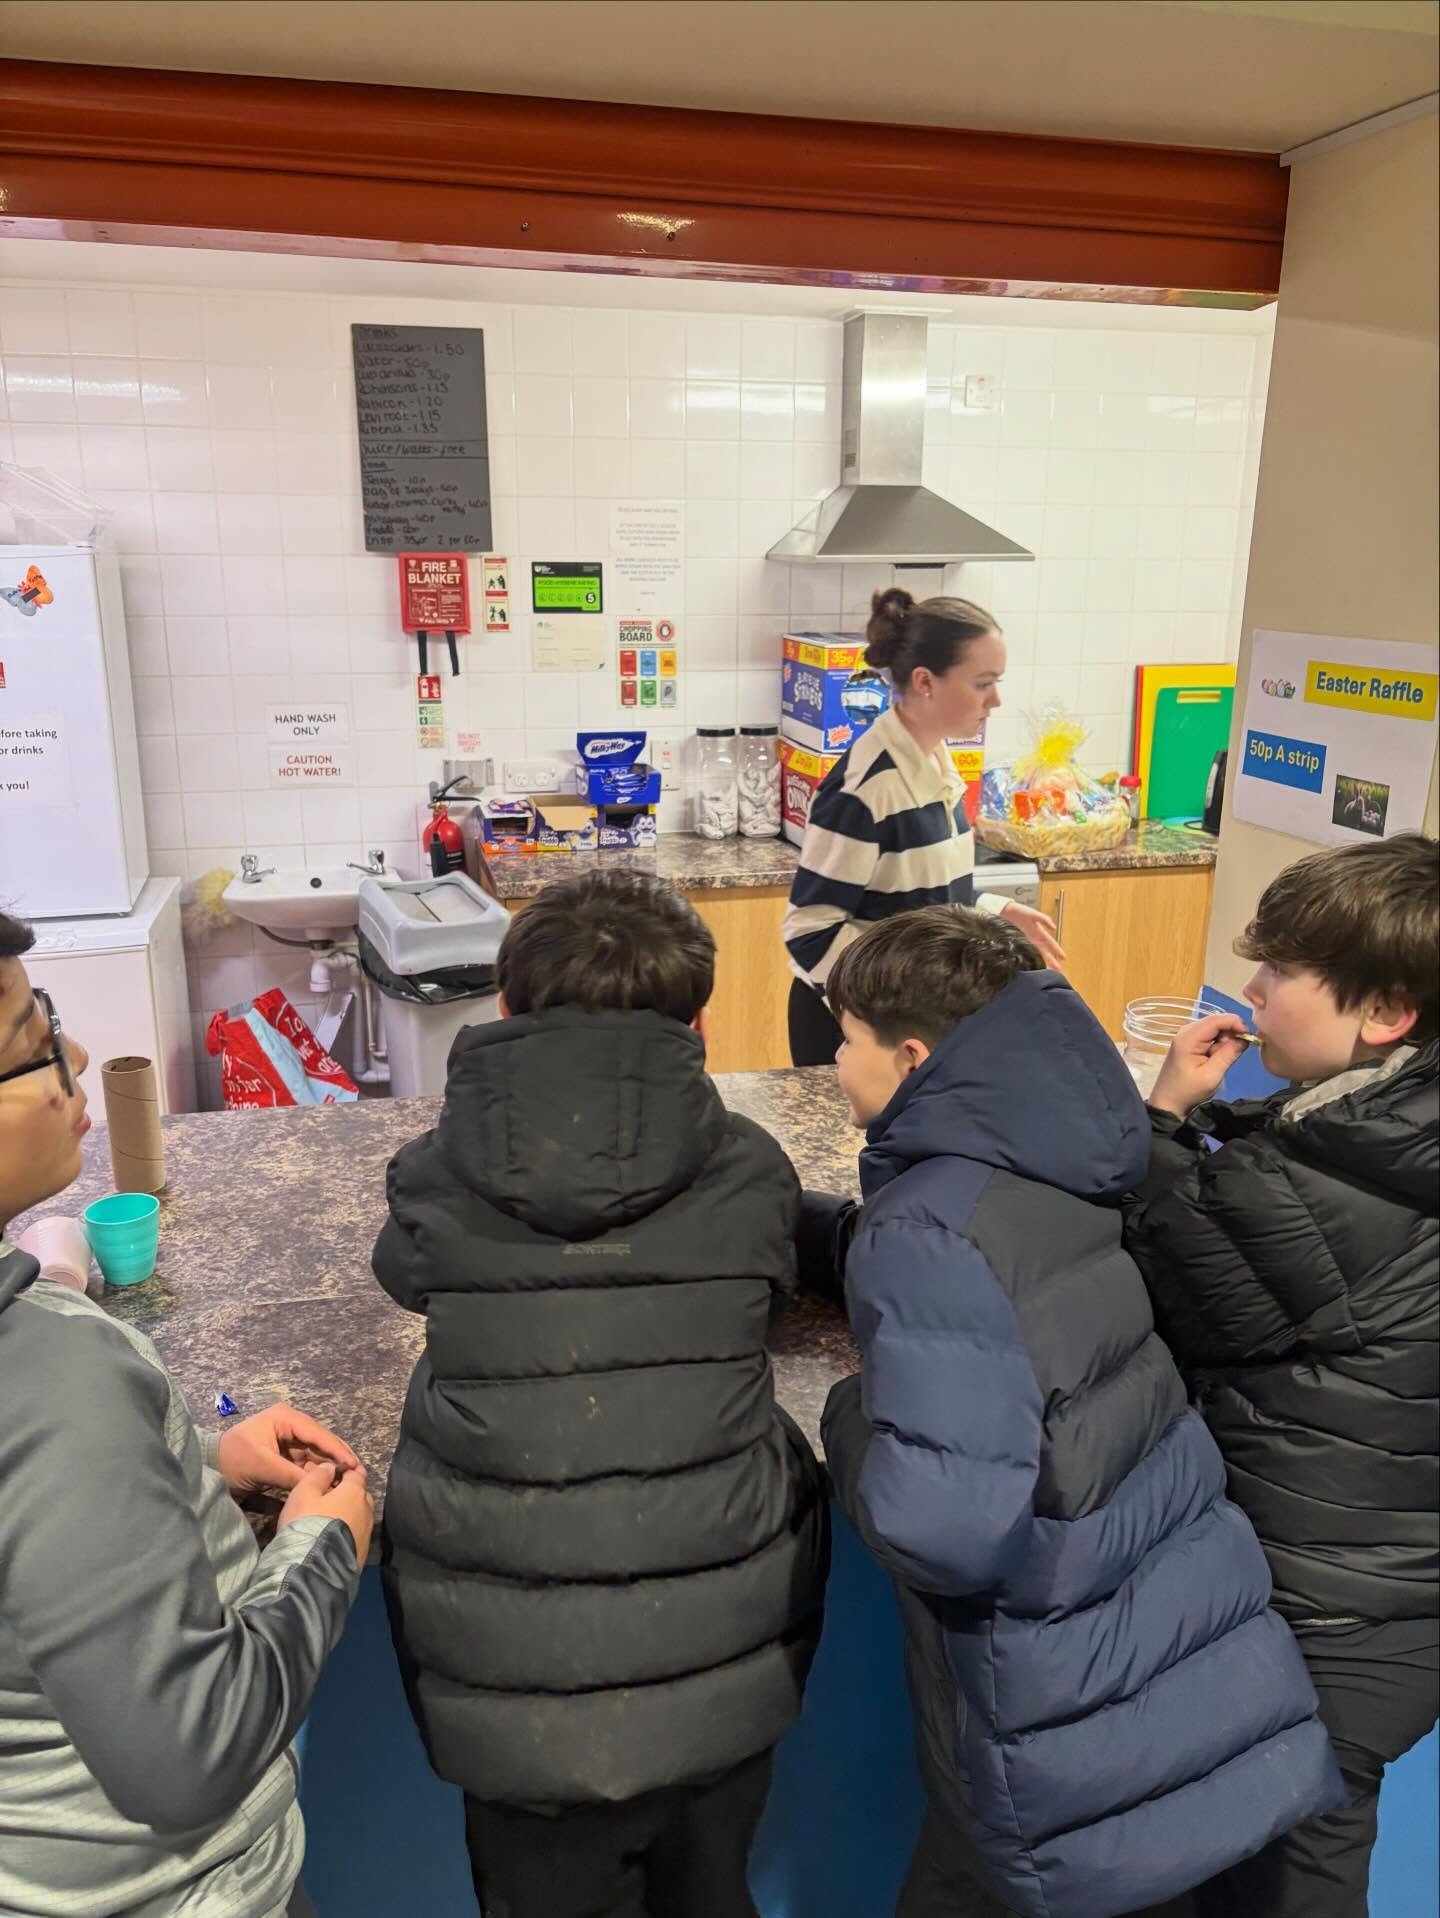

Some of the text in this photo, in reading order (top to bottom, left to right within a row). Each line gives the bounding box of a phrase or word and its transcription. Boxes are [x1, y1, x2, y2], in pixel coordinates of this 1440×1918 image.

[421, 561, 447, 573] FIRE
[408, 573, 461, 584] BLANKET
[619, 632, 652, 642] BOARD
[832, 651, 853, 665] 35p
[1316, 671, 1424, 703] Easter Raffle
[274, 713, 336, 724] HAND WASH
[0, 729, 57, 739] fore taking
[293, 727, 320, 736] ONLY
[11, 745, 44, 755] drinks
[286, 755, 332, 764] CAUTION
[1250, 739, 1319, 773] 50p A strip
[278, 767, 341, 776] HOT WATER!
[6, 780, 30, 791] you!
